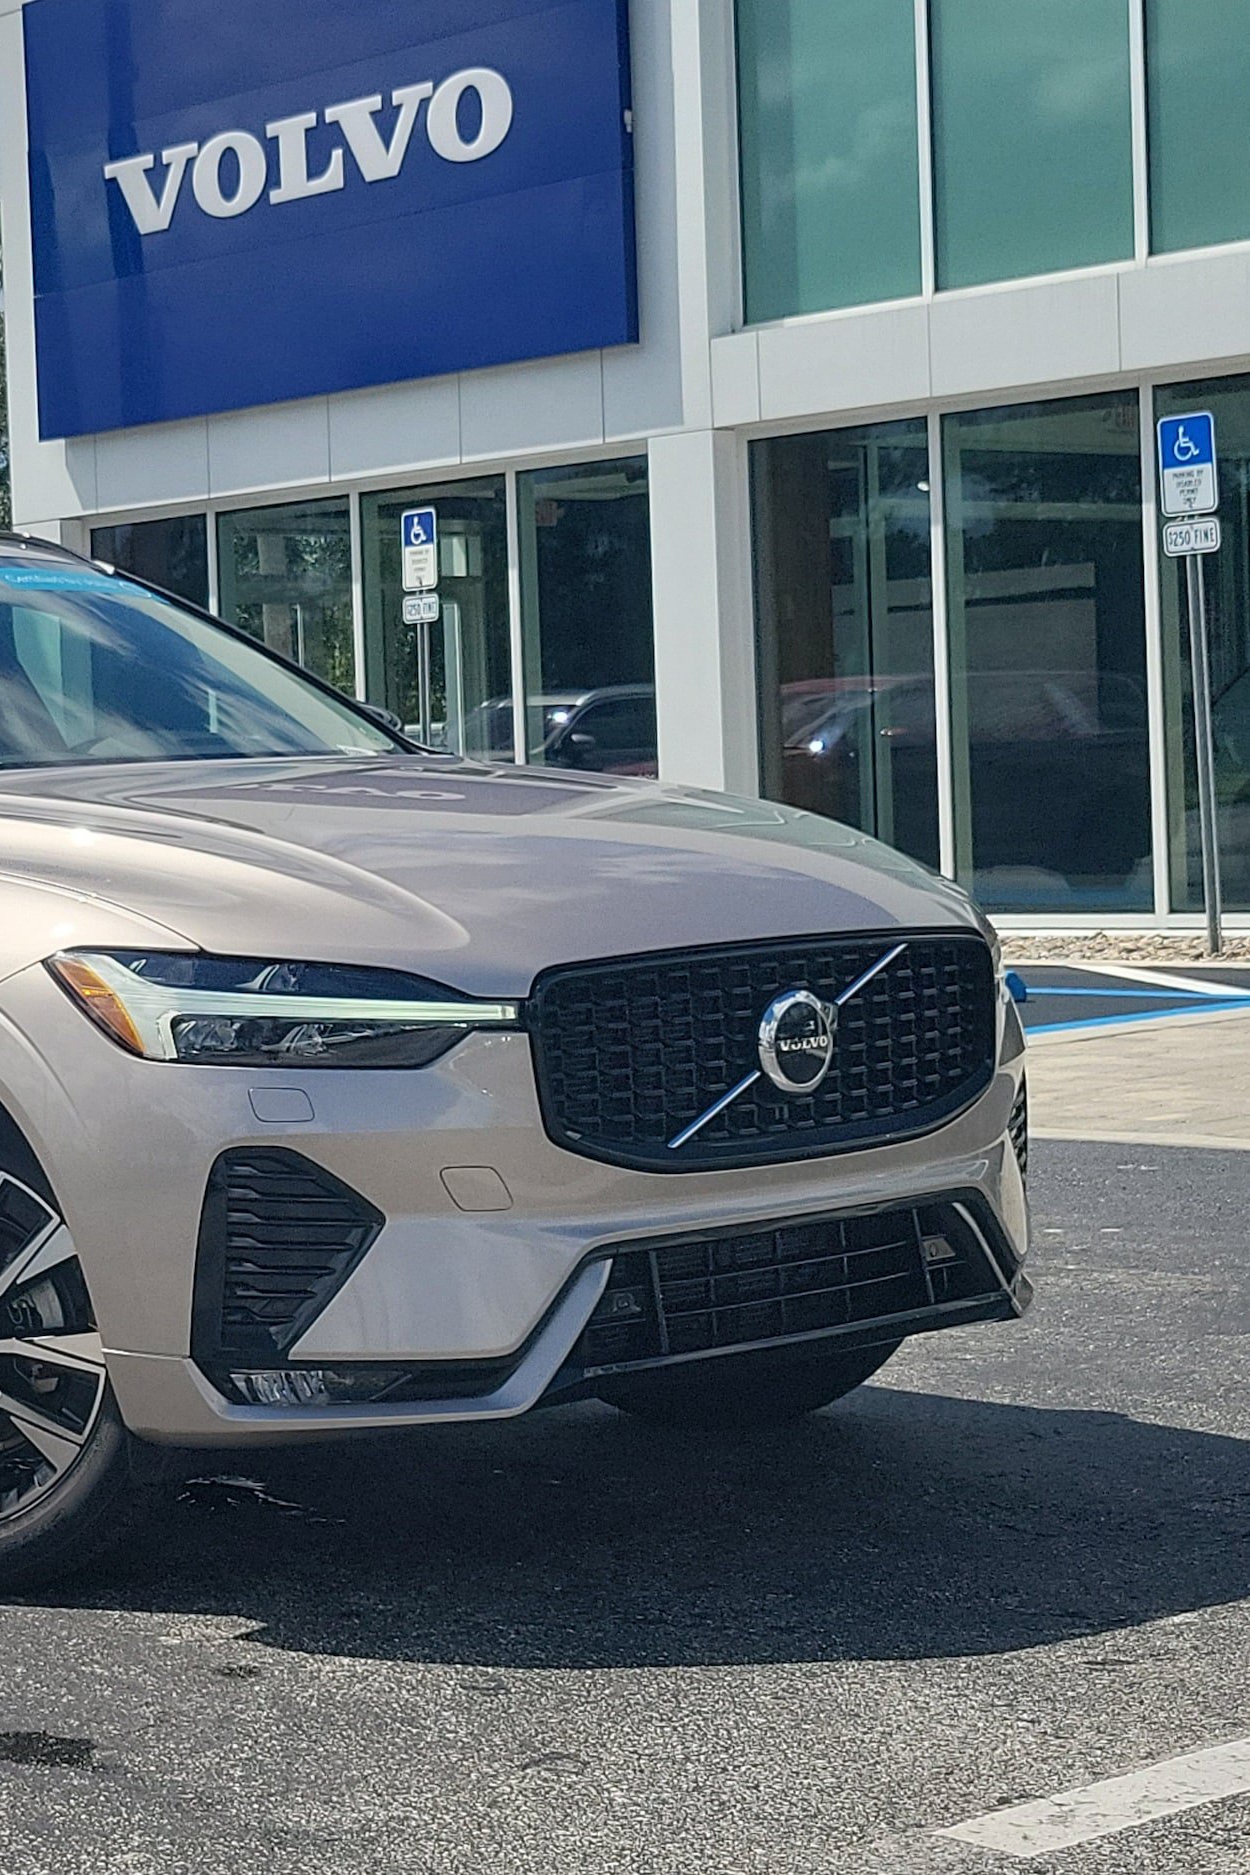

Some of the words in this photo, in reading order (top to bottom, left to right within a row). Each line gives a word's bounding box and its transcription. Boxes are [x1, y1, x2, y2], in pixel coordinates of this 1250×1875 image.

[104, 67, 513, 235] VOLVO
[1168, 529, 1191, 548] $250
[1194, 526, 1215, 545] FINE
[779, 1035, 828, 1052] VOLVO
